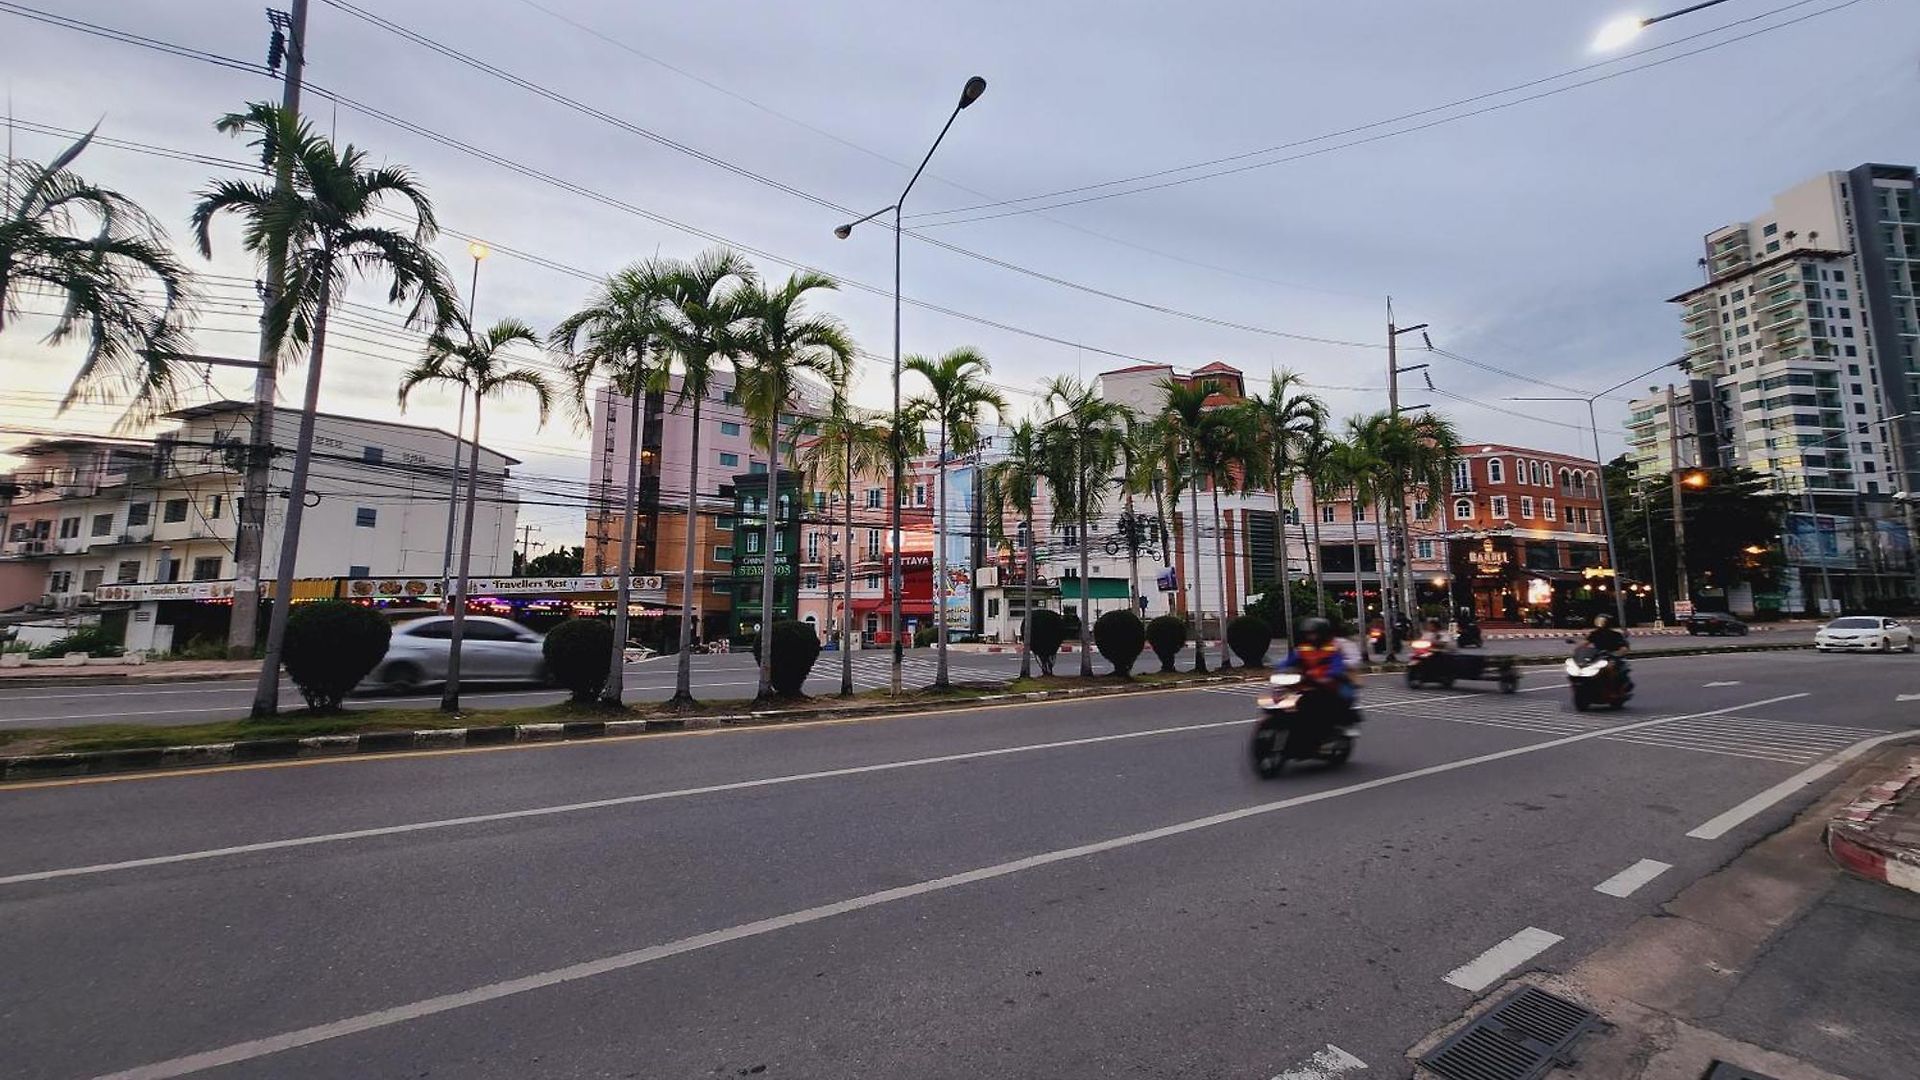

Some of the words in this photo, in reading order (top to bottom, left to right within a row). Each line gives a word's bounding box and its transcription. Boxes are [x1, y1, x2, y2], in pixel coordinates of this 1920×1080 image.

[887, 556, 929, 566] PTTAYA
[492, 579, 543, 589] Travellers
[545, 578, 568, 588] Rest
